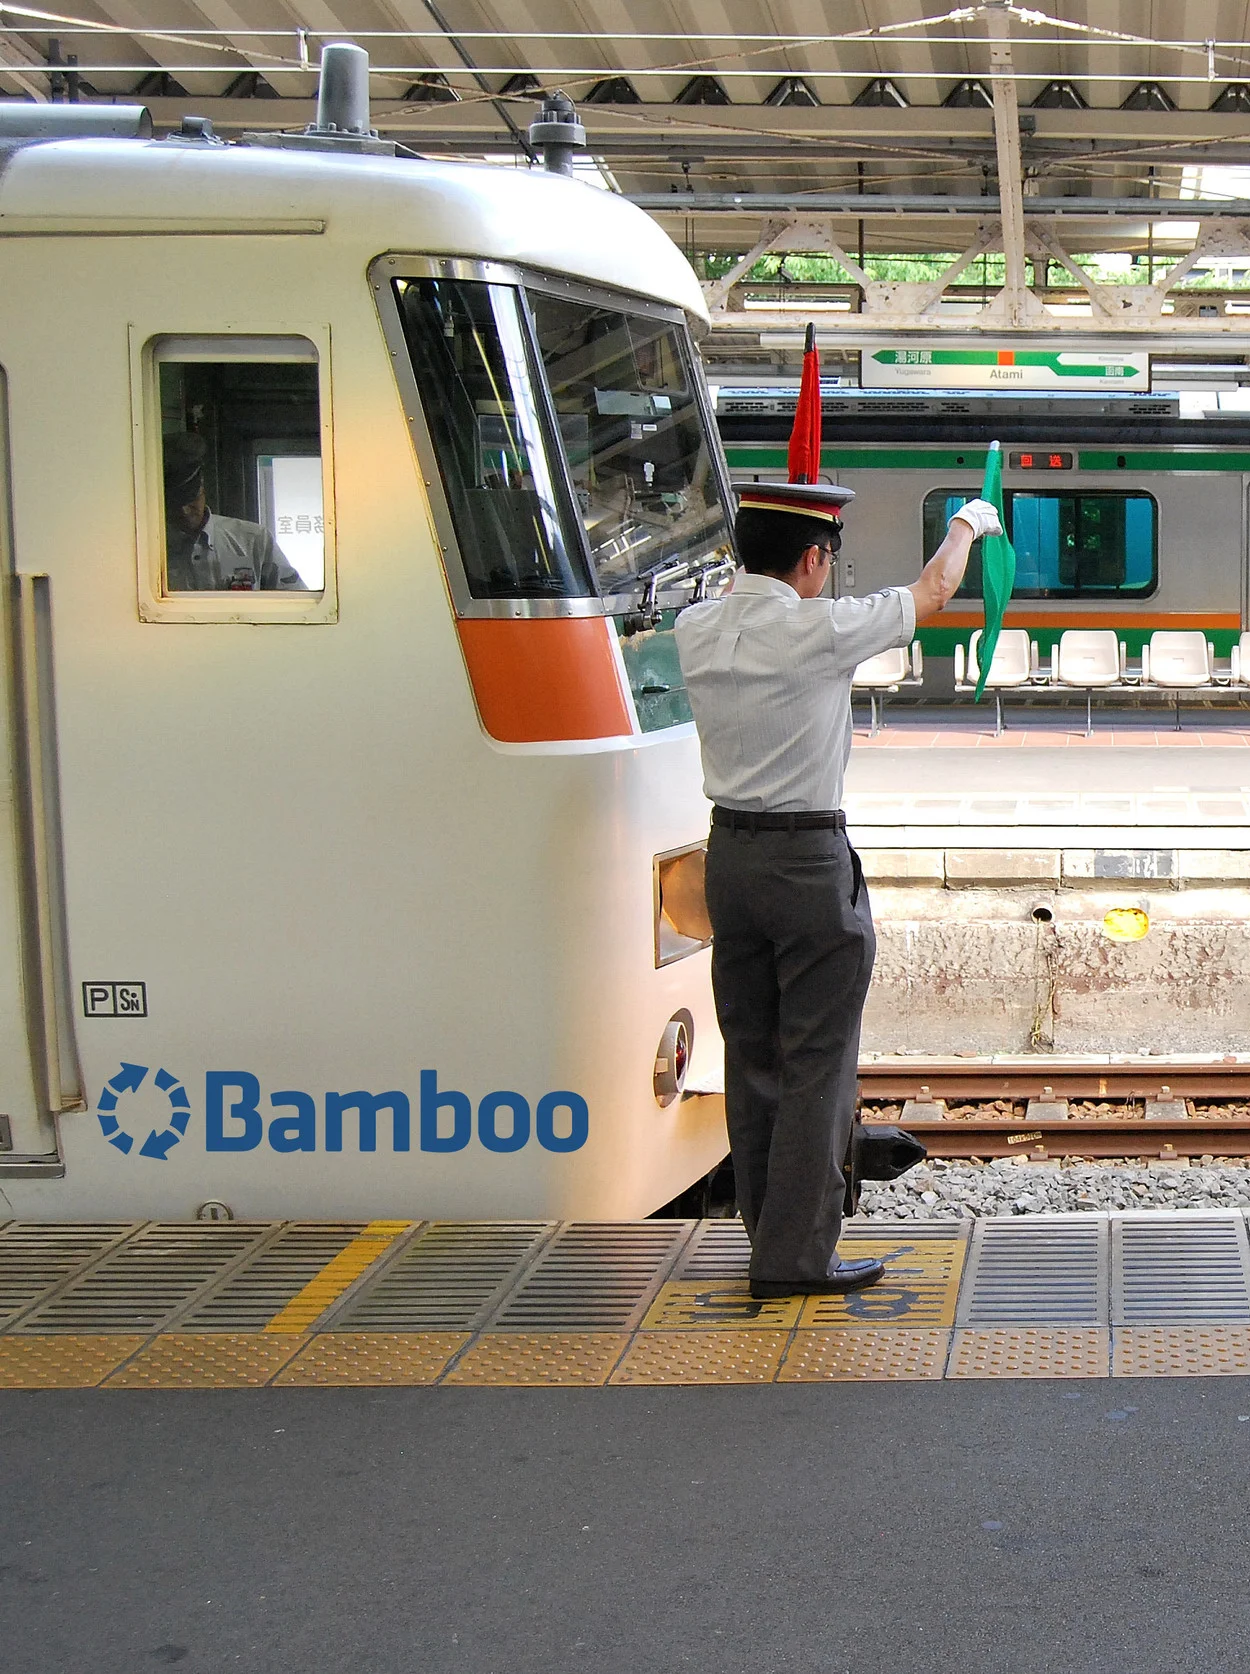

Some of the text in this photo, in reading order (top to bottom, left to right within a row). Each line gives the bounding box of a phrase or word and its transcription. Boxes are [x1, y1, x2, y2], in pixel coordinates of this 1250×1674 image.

[895, 350, 932, 364] 湯河原
[895, 367, 931, 376] Yugawara
[990, 369, 1023, 379] Atami
[1021, 454, 1062, 468] 回送
[206, 1069, 589, 1153] Bamboo
